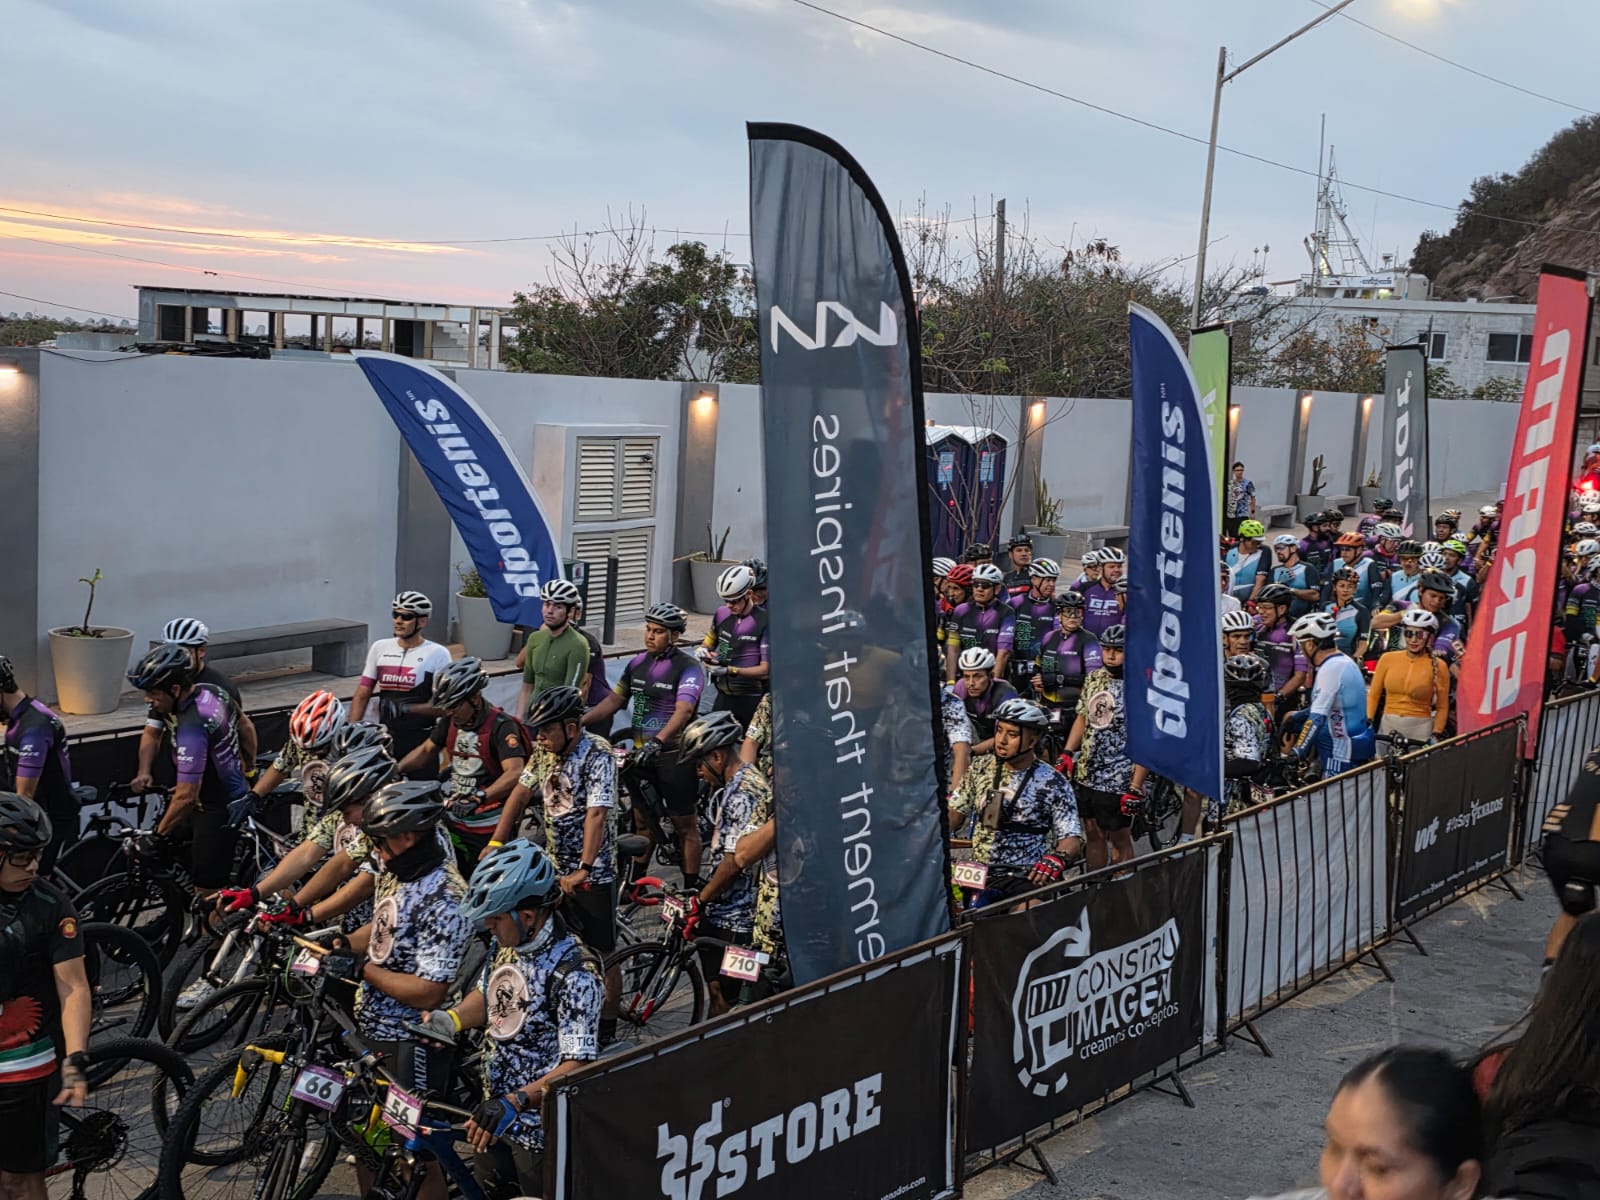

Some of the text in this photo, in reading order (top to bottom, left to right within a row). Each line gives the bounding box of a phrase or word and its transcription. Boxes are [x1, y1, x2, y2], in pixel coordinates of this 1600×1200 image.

[414, 398, 540, 598] dportenis
[1146, 401, 1190, 739] dportenis
[956, 868, 982, 882] 706
[729, 955, 755, 972] 710
[1077, 927, 1177, 1003] CONSTRU
[304, 1075, 335, 1100] 66
[390, 1099, 410, 1121] 56
[716, 1072, 882, 1199] STORE
